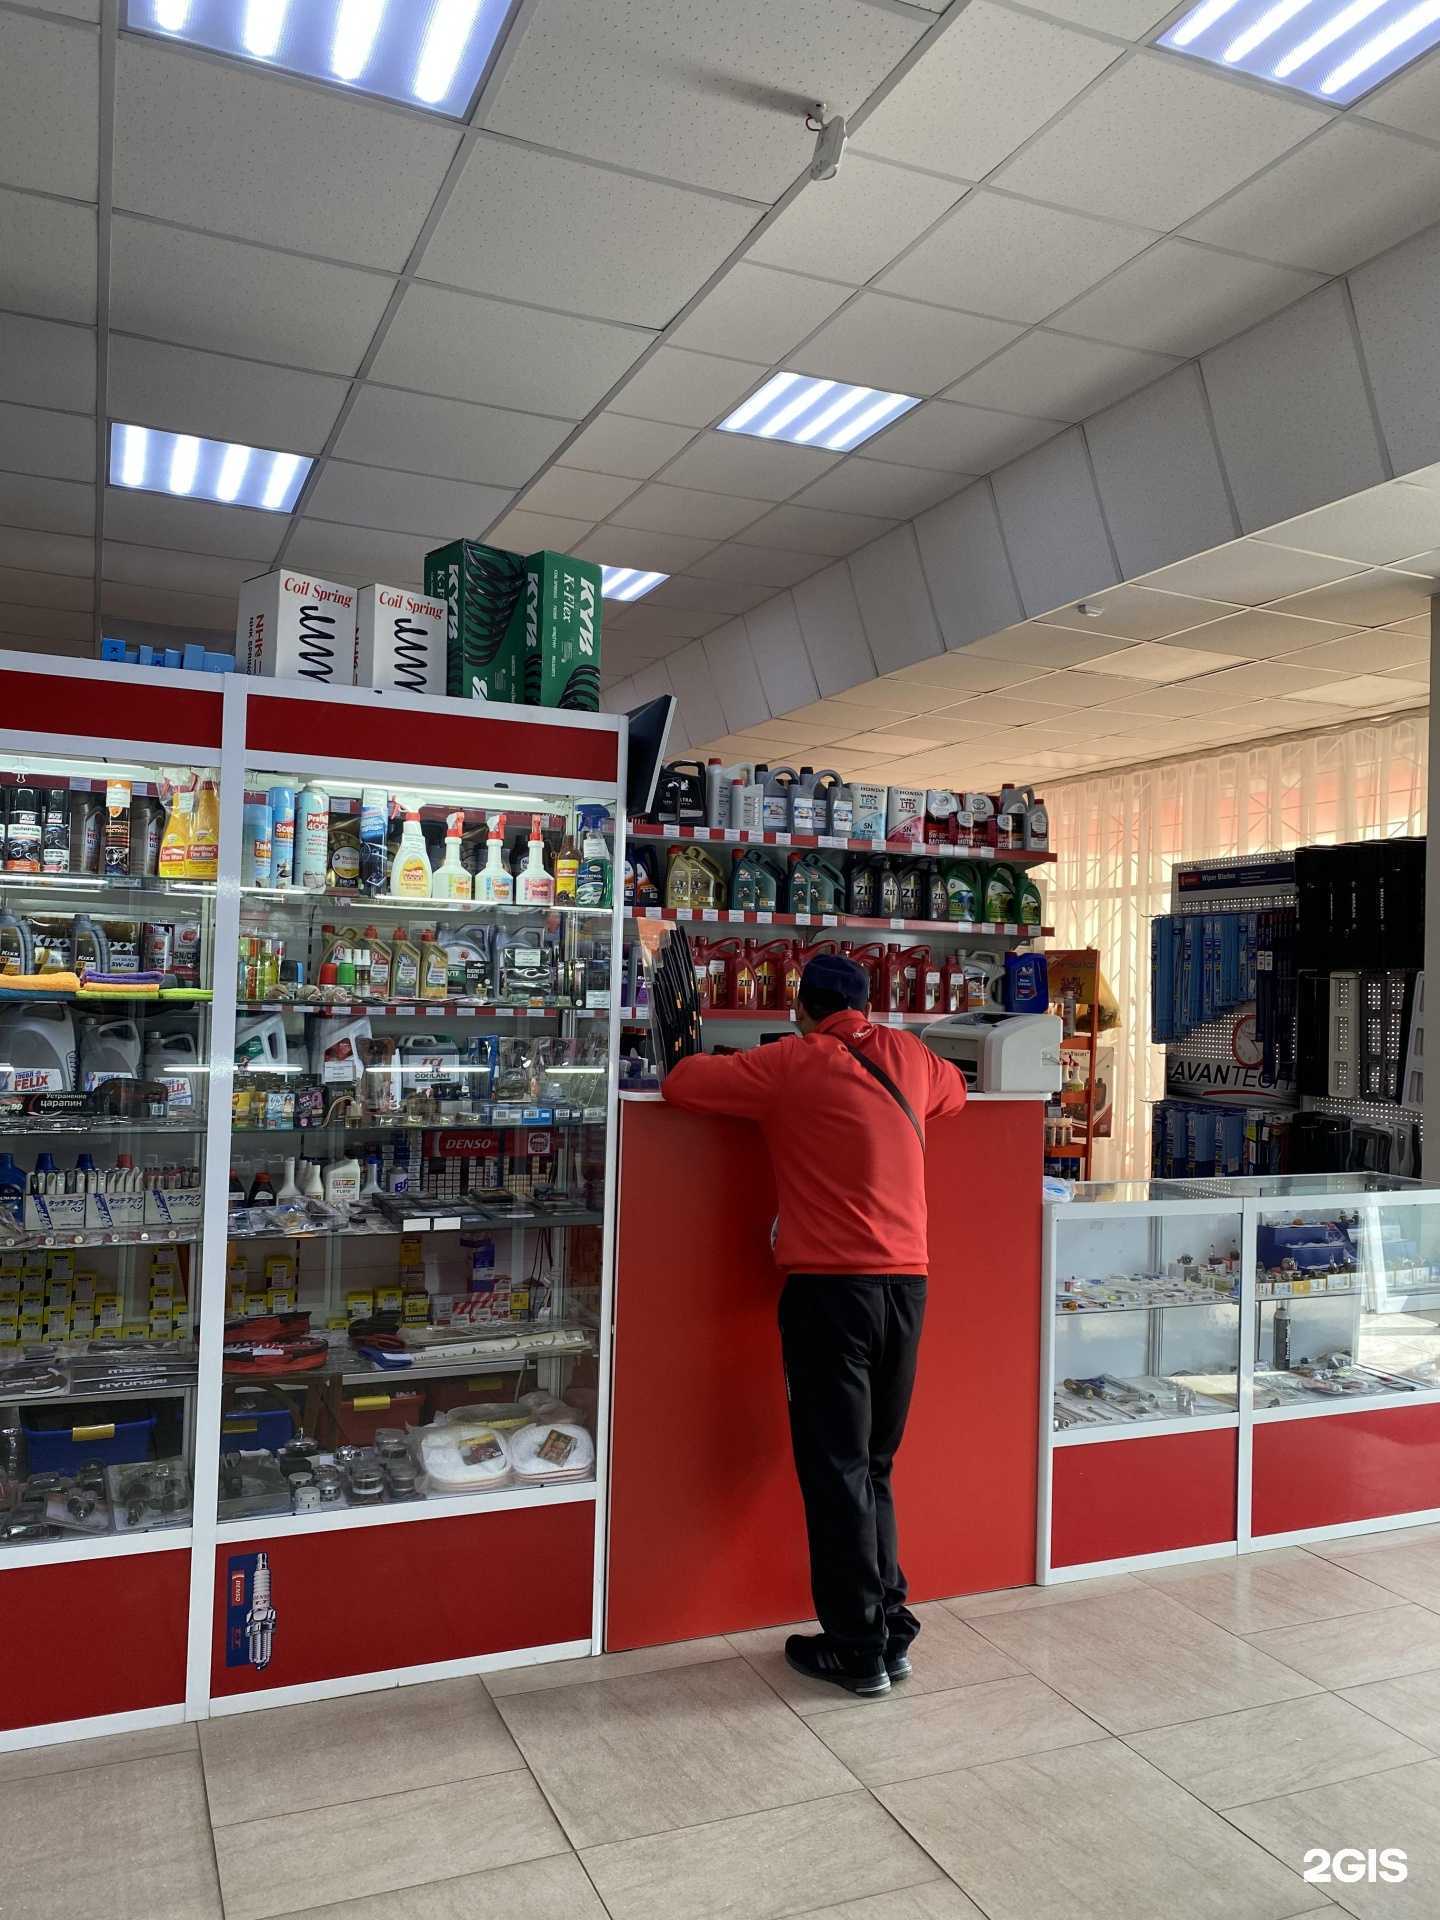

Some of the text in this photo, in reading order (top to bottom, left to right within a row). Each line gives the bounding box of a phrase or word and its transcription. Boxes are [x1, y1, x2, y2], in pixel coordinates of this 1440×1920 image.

[284, 577, 353, 609] Coil Spring
[379, 591, 444, 620] Coil Spring
[448, 564, 459, 640] KYB
[526, 572, 539, 648] KYB
[579, 576, 595, 656] KYB
[901, 801, 915, 810] LTD
[864, 822, 873, 830] SN
[902, 825, 912, 833] SN
[15, 1075, 49, 1091] FELIX
[40, 1100, 82, 1108] царапин
[445, 1138, 492, 1149] DENSO
[99, 1379, 167, 1389] HYUNDAI
